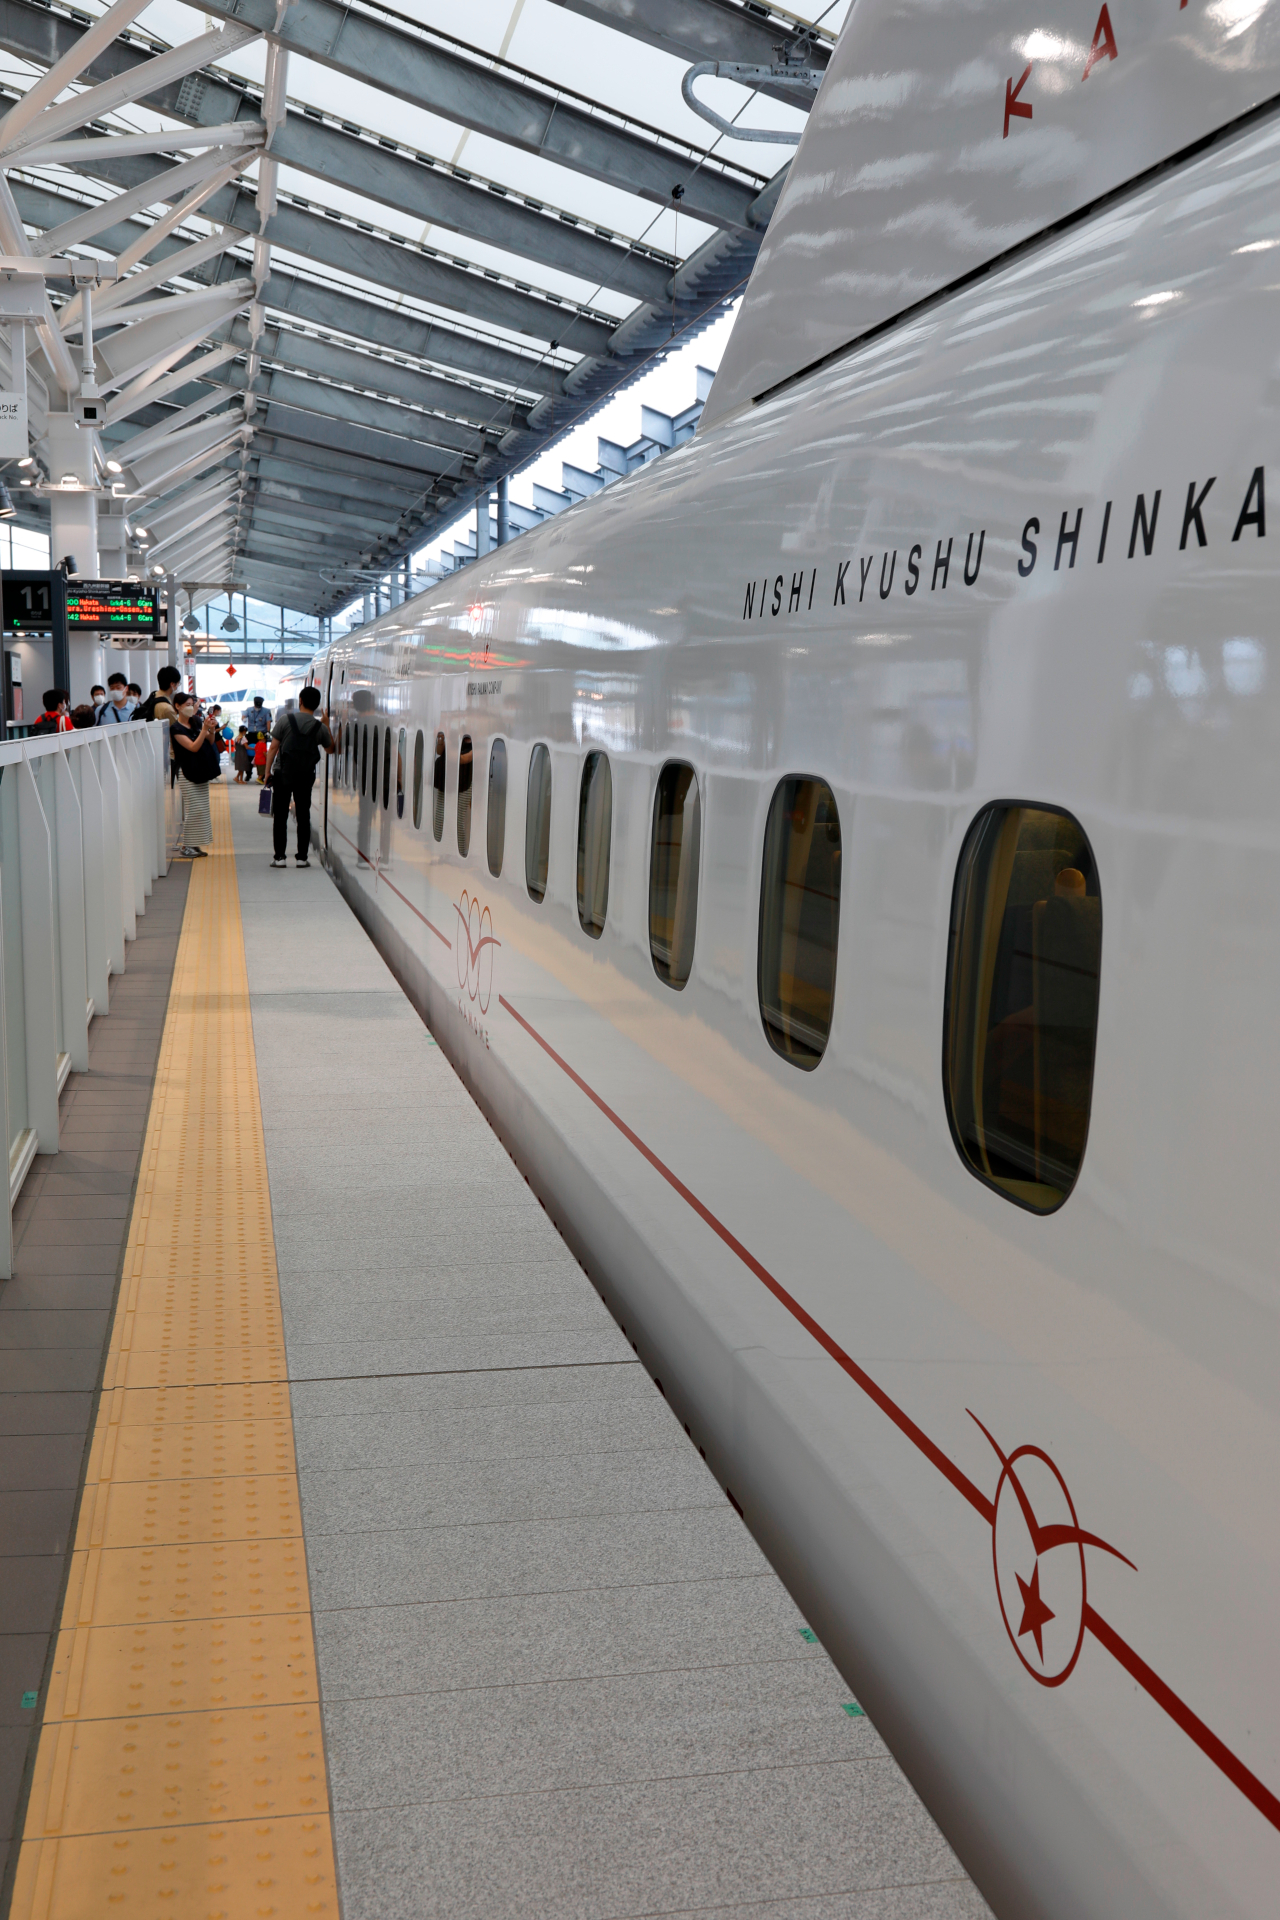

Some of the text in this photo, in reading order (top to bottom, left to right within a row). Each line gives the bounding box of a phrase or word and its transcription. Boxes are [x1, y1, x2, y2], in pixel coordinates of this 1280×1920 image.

[0, 404, 18, 413] りば
[743, 465, 1266, 620] NISHI KYUSHU SHINKA
[20, 586, 49, 610] 11
[79, 613, 100, 621] Hakata
